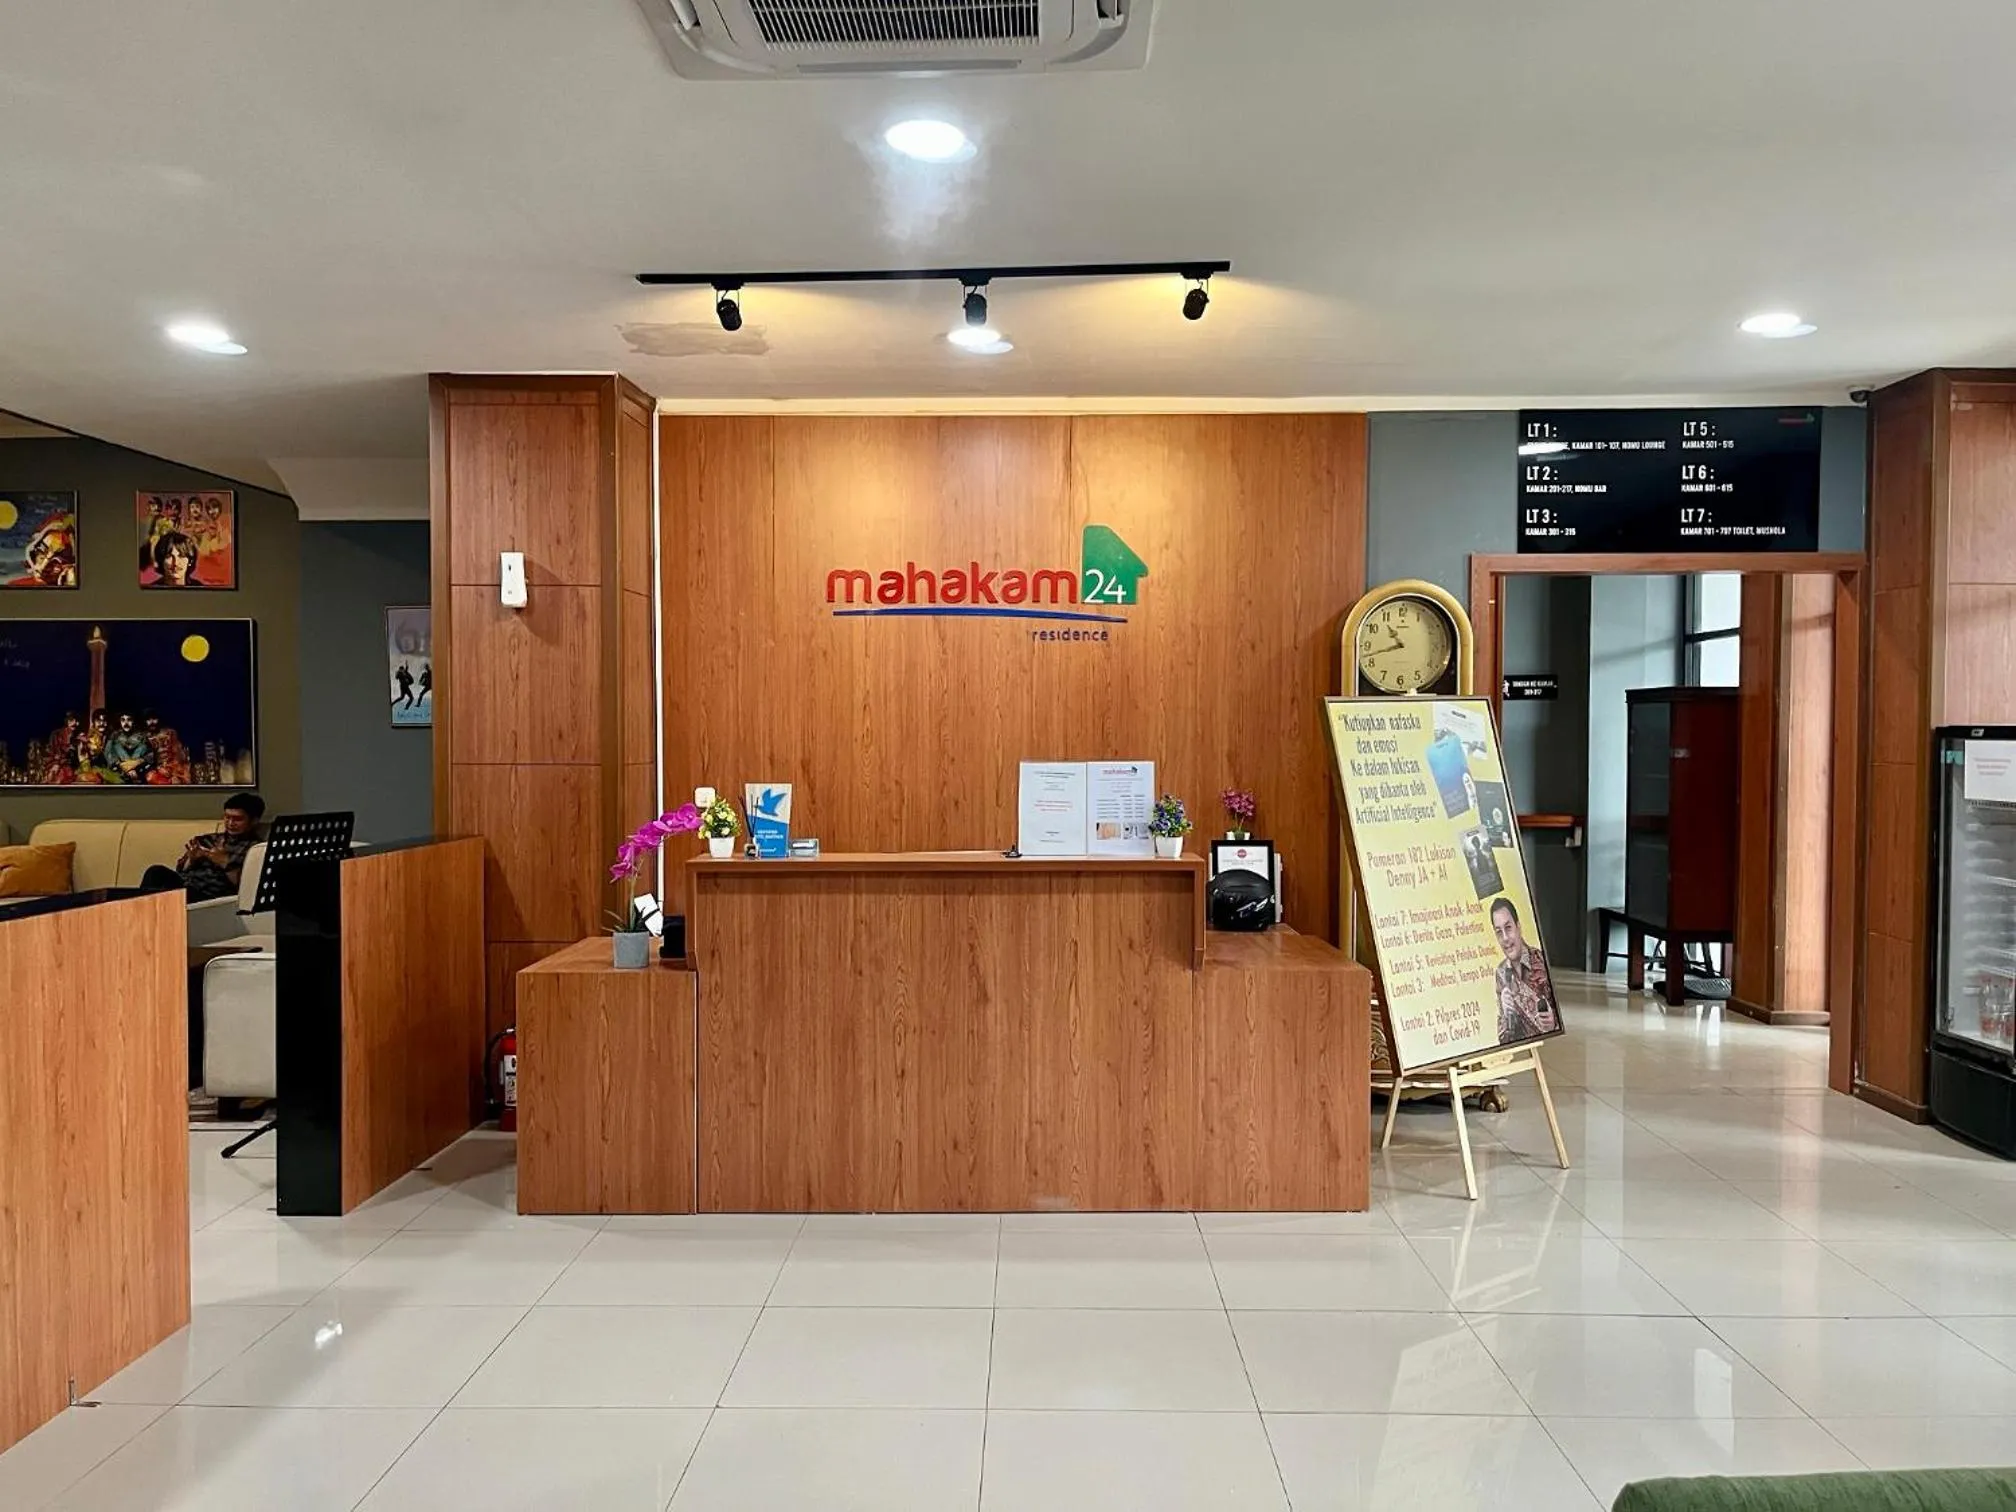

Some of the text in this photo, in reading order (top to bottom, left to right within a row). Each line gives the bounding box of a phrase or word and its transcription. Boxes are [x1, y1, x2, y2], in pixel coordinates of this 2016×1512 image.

[1527, 423, 1540, 437] LT
[1683, 421, 1696, 436] LT
[1572, 441, 1593, 450] KAMAR
[1641, 440, 1666, 449] LOUNGE
[1682, 440, 1704, 449] KAMAR
[1706, 440, 1717, 449] 501
[1526, 466, 1539, 480] LT
[1682, 465, 1695, 480] LT
[1526, 484, 1547, 493] KAMAR
[1594, 484, 1607, 493] BAR
[1681, 484, 1703, 492] KAMAR
[1526, 509, 1539, 523] LT
[1681, 508, 1694, 523] LT
[1525, 528, 1547, 536] KAMAR
[1681, 527, 1702, 535] KAMAR
[1733, 527, 1755, 536] TOILET,
[826, 561, 1127, 604] mahakam 24
[1382, 611, 1391, 622] 11
[1398, 607, 1408, 617] 12
[1031, 627, 1109, 641] residence
[1368, 623, 1379, 634] 10
[1363, 641, 1371, 651] 9
[1368, 657, 1375, 667] 8
[1380, 670, 1387, 681] 7
[1397, 675, 1404, 685] 6
[1414, 670, 1421, 681] 5
[1389, 713, 1421, 731] nafasku
[1356, 735, 1398, 754] dan emosi
[1350, 757, 1421, 776] Ke dalam lukisan
[1358, 780, 1427, 804] yang dibantu oleh
[1356, 806, 1390, 824] Artificial
[1366, 843, 1456, 868] Pameran 182 Lukisan
[1386, 869, 1416, 889] Denny
[1418, 865, 1429, 884] JA
[1439, 863, 1448, 881] AI
[1375, 911, 1399, 930] Lantai
[1408, 905, 1444, 924] Imajinasi
[1466, 900, 1484, 915] Anak
[1380, 932, 1404, 949] Lantai
[1455, 921, 1485, 936] Palestina
[1389, 957, 1414, 975] Lantai
[1391, 978, 1416, 998] Lantai
[1400, 1011, 1425, 1031] Lantai
[1435, 1007, 1461, 1026] Pilpres
[1461, 1001, 1480, 1020] 2024
[1433, 1019, 1481, 1046] dan Covid-19
